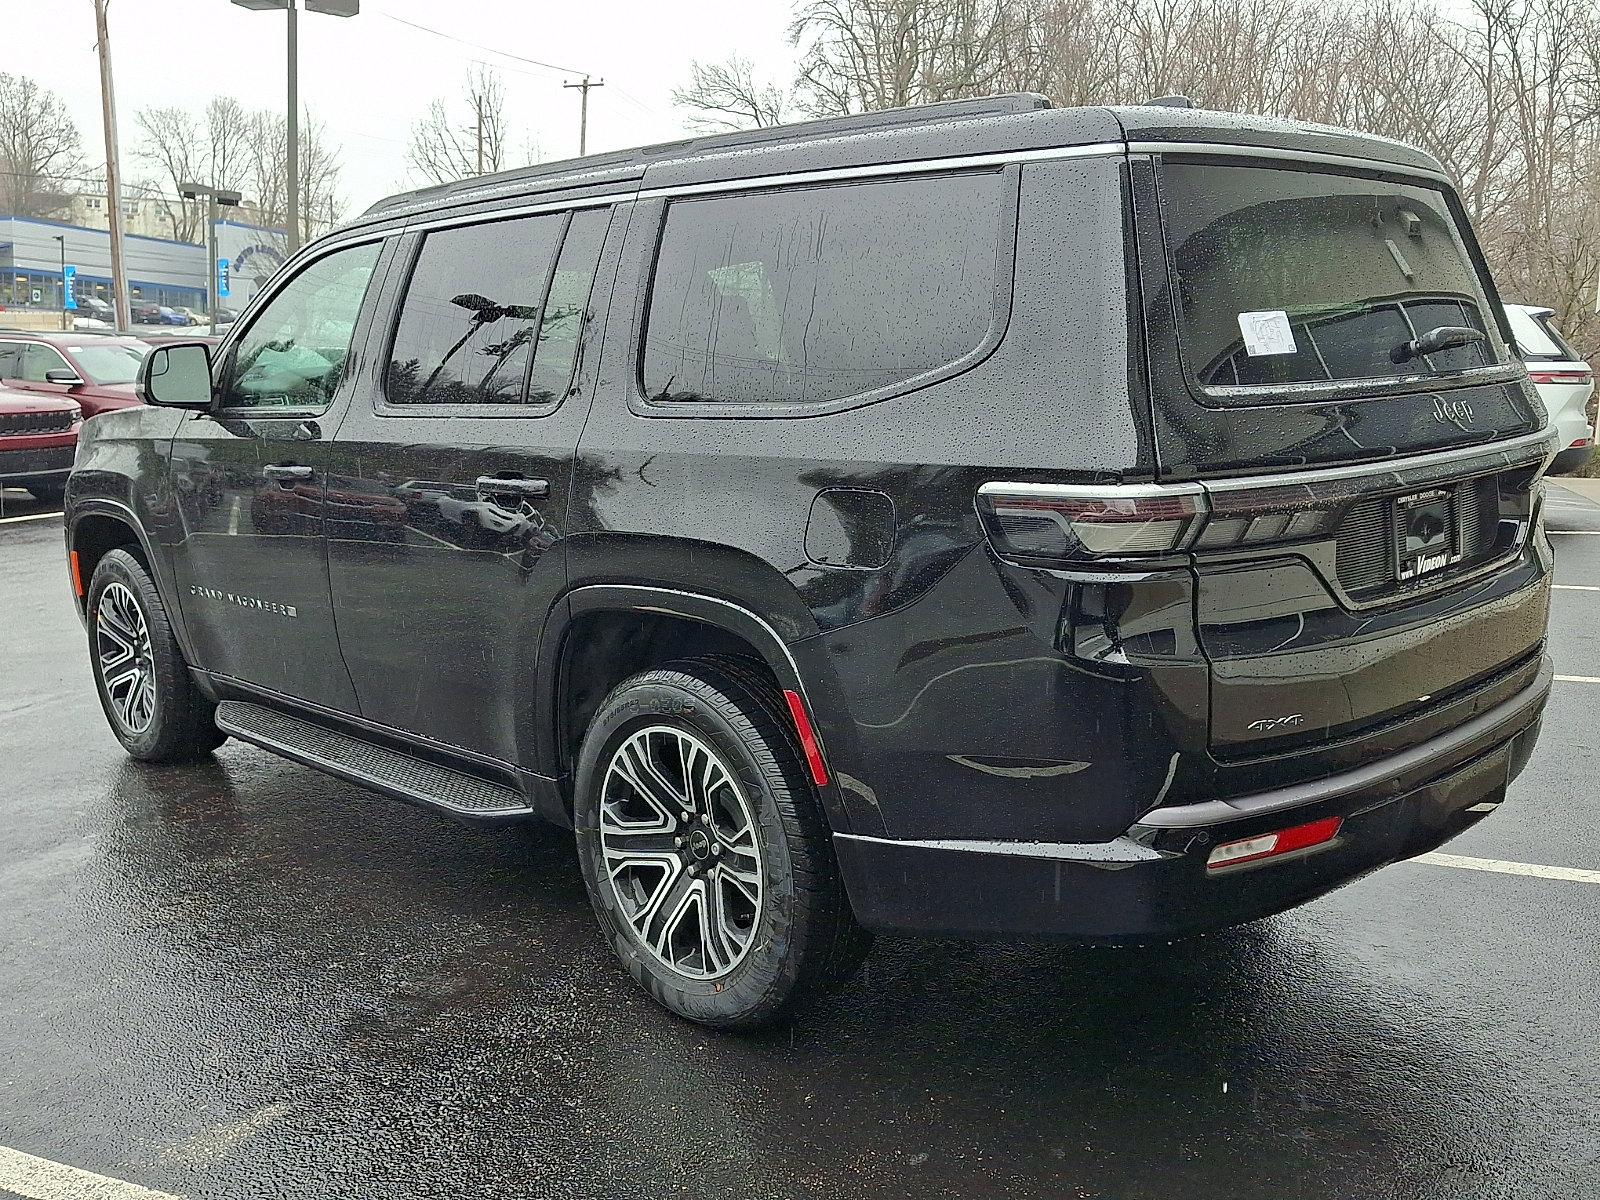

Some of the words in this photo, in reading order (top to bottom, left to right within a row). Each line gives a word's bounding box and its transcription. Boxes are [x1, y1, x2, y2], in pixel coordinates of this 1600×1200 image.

[1433, 398, 1475, 424] Jeep
[1397, 494, 1418, 504] CHRYSLER
[1419, 489, 1435, 499] DODGE
[190, 585, 223, 600] GRAND
[227, 593, 287, 616] WAGONEER
